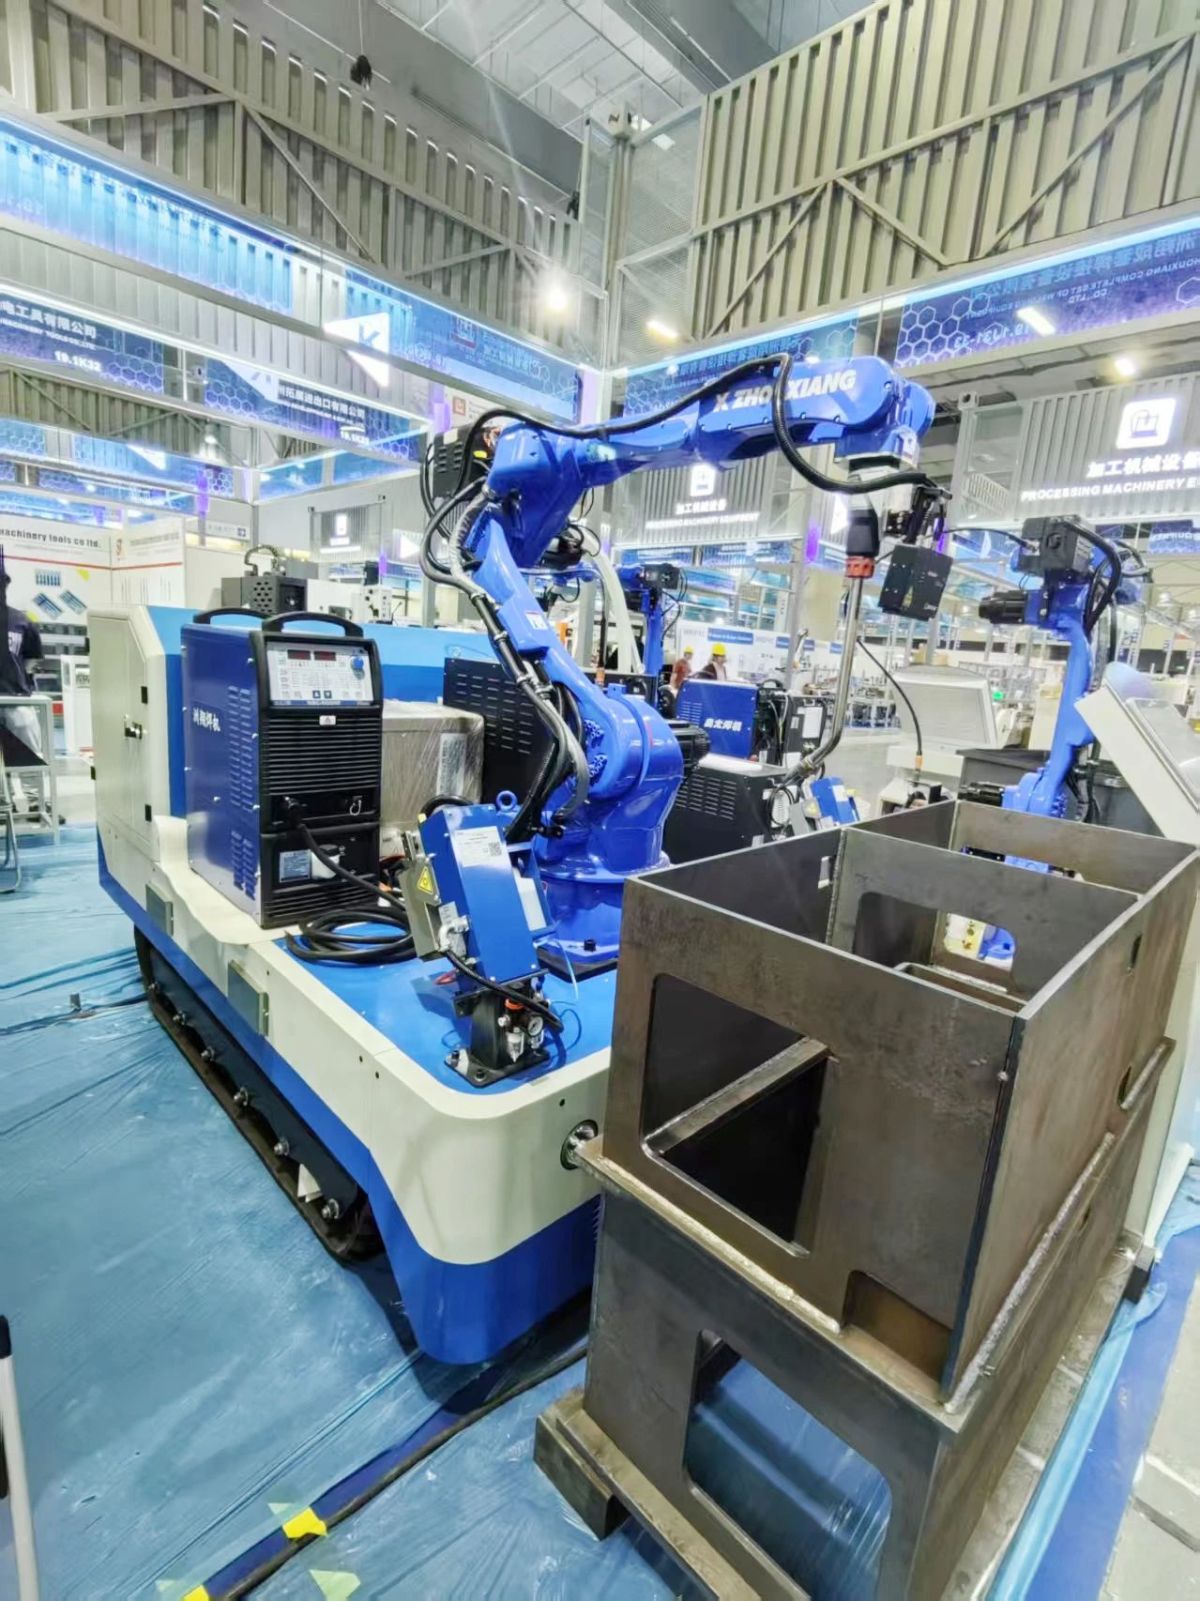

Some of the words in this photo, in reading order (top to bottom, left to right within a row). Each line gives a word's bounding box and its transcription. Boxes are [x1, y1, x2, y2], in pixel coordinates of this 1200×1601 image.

[1020, 484, 1102, 503] PROCESSING
[1103, 477, 1185, 496] MACHINERY
[49, 533, 72, 545] tools
